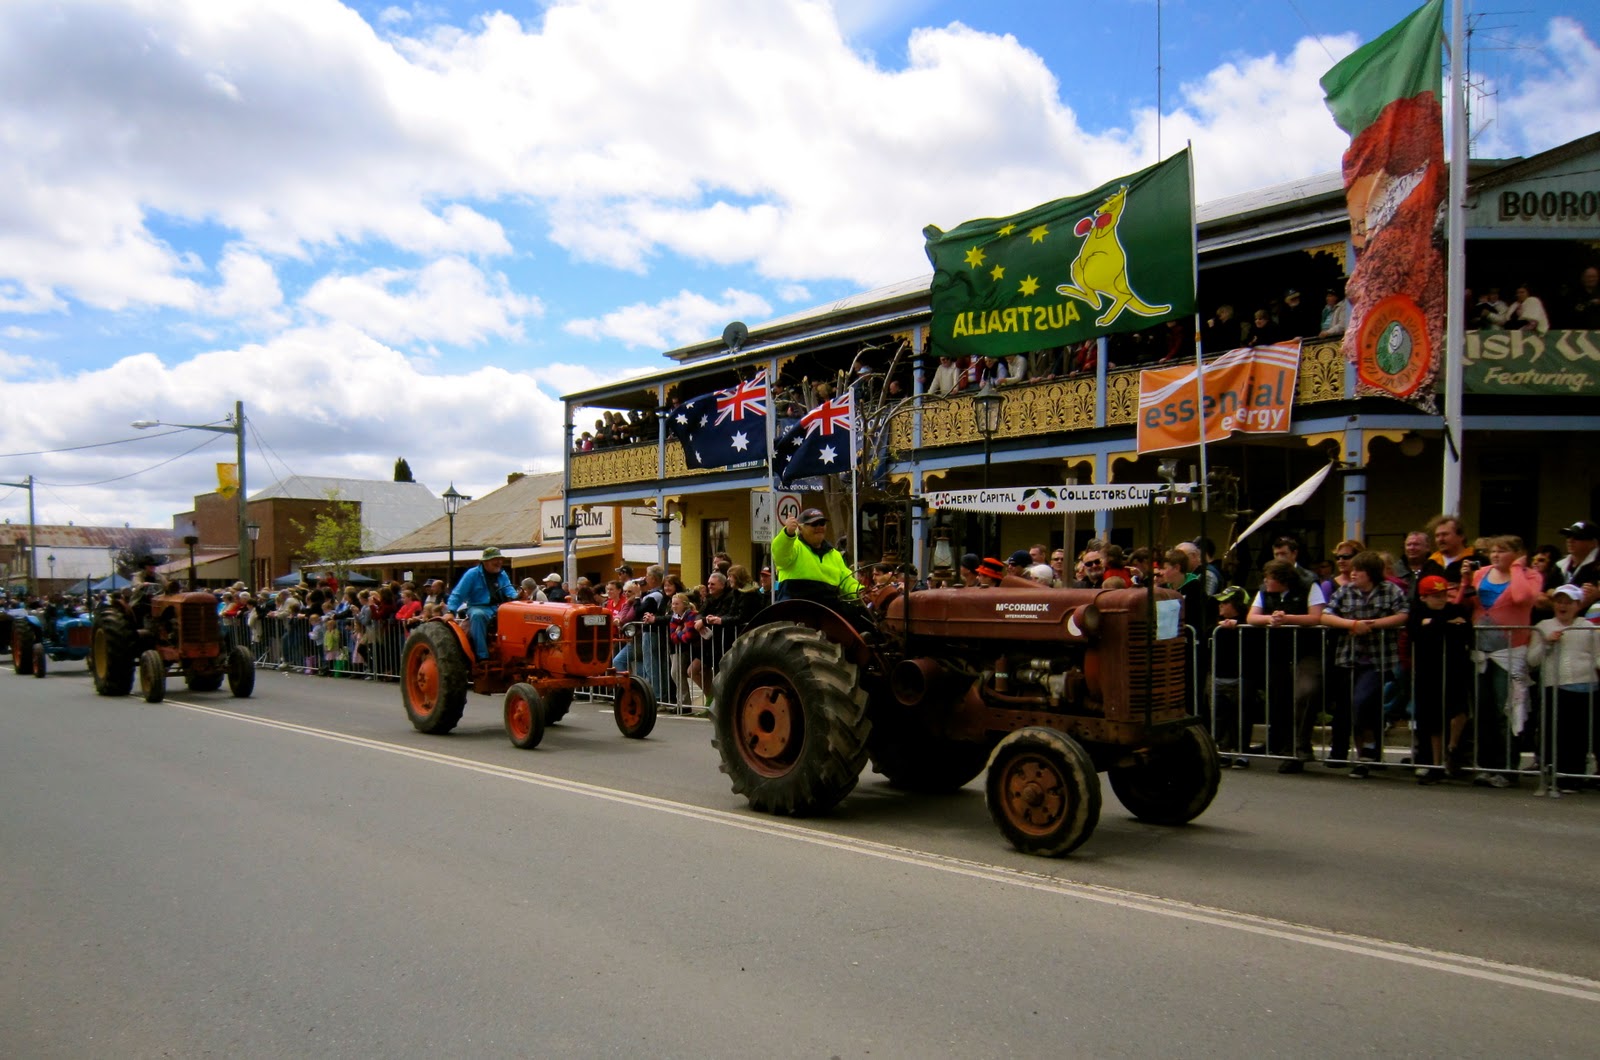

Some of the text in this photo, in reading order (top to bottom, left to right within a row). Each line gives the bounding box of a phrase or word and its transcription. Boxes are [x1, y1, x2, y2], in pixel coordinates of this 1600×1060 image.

[1500, 190, 1600, 219] BOORO
[1145, 370, 1287, 429] essenial
[1220, 407, 1286, 431] eergy
[979, 490, 1017, 503] CAPITAL
[1059, 487, 1127, 501] COLLECTORS
[550, 511, 604, 529] MEUM
[781, 504, 798, 520] 40
